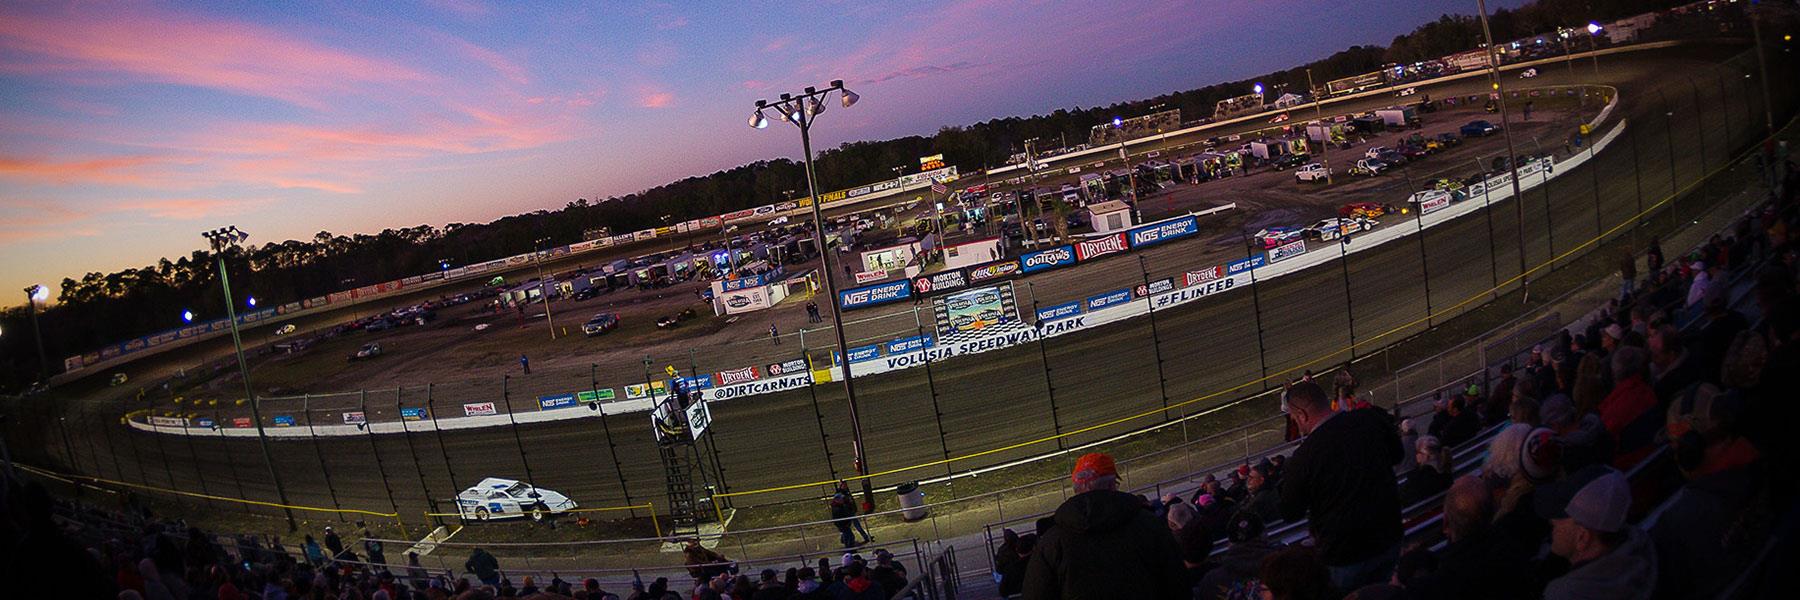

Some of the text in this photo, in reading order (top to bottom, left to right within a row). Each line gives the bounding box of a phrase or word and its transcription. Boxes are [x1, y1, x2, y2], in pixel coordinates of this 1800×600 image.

[823, 191, 846, 204] FINALS
[1161, 219, 1193, 232] ENERGY
[1135, 227, 1160, 244] NOS
[1161, 228, 1187, 238] DRINK
[1081, 233, 1124, 259] DRYDENE
[1026, 250, 1070, 266] OUTLAWS
[933, 271, 961, 283] MORTON
[1187, 266, 1217, 286] DRYDENE
[872, 283, 906, 295] ENERGY
[932, 277, 965, 291] BUILDINGS
[844, 289, 871, 305] NOS
[871, 292, 898, 301] DRINK
[1158, 278, 1234, 306] #FLINFEB
[888, 317, 1085, 368] VOLUSIA SPEEDWAY PARK
[783, 359, 804, 369] MORTON
[836, 353, 854, 362] NS
[720, 367, 755, 385] DRYDENE
[465, 402, 493, 412] WHELEN
